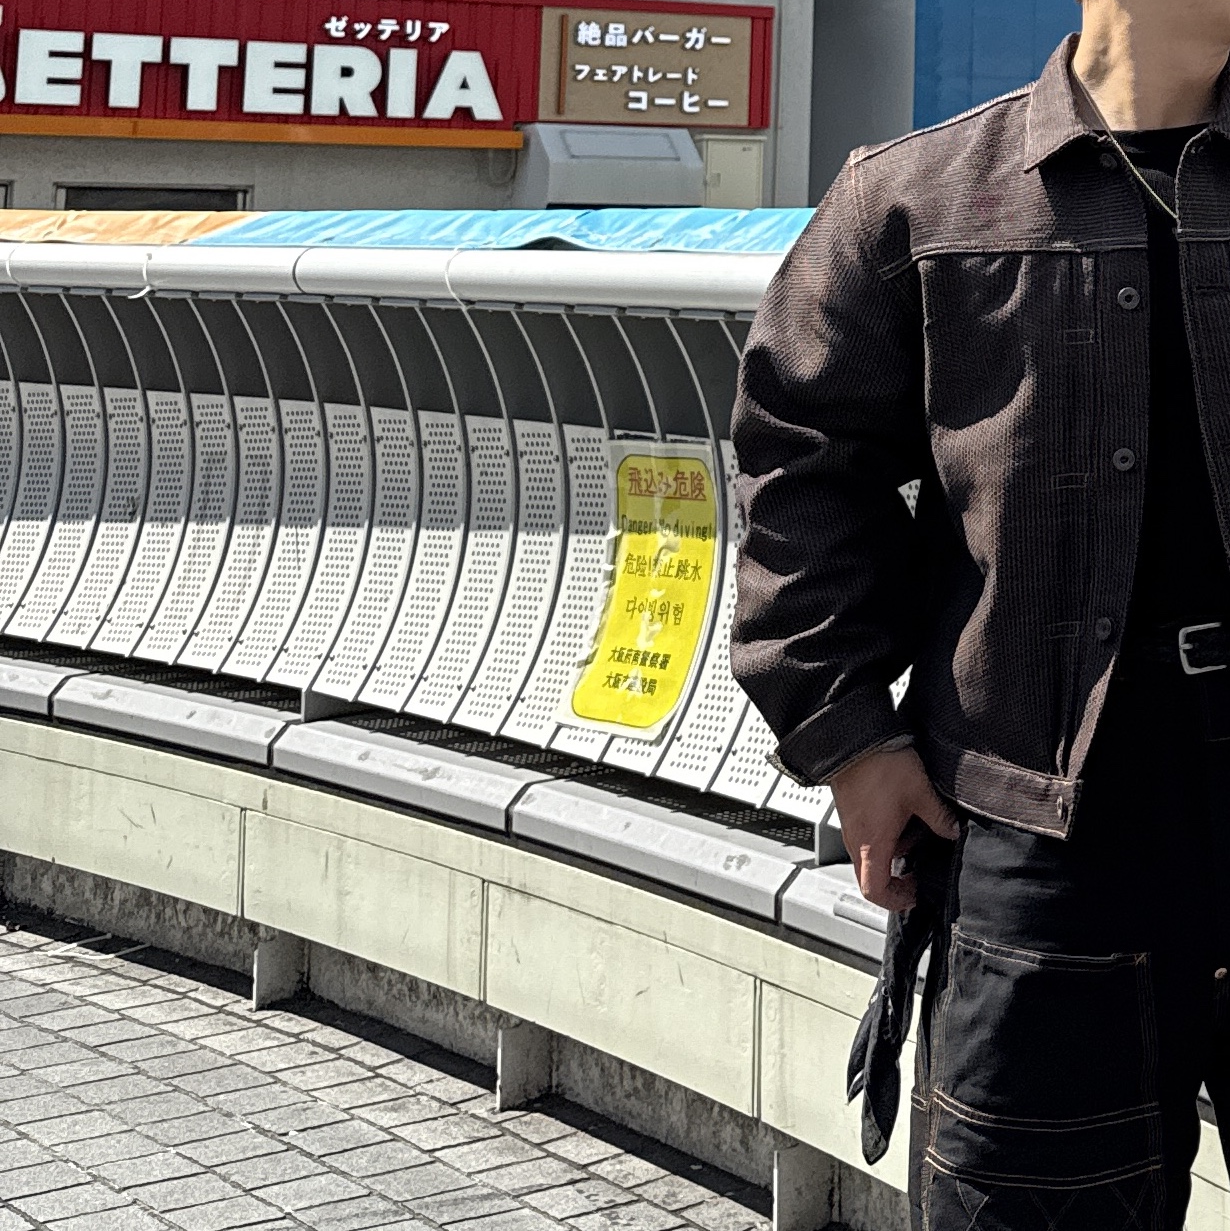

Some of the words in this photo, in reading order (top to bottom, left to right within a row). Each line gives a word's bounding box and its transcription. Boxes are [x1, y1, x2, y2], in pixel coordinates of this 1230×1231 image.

[323, 15, 452, 44] ゼッテリア
[575, 20, 732, 51] 絶品バーガー
[0, 4, 504, 122] ETTERIA
[574, 63, 701, 86] フェアトレード
[627, 90, 730, 114] コーヒー
[627, 466, 707, 500] 飛込み危険
